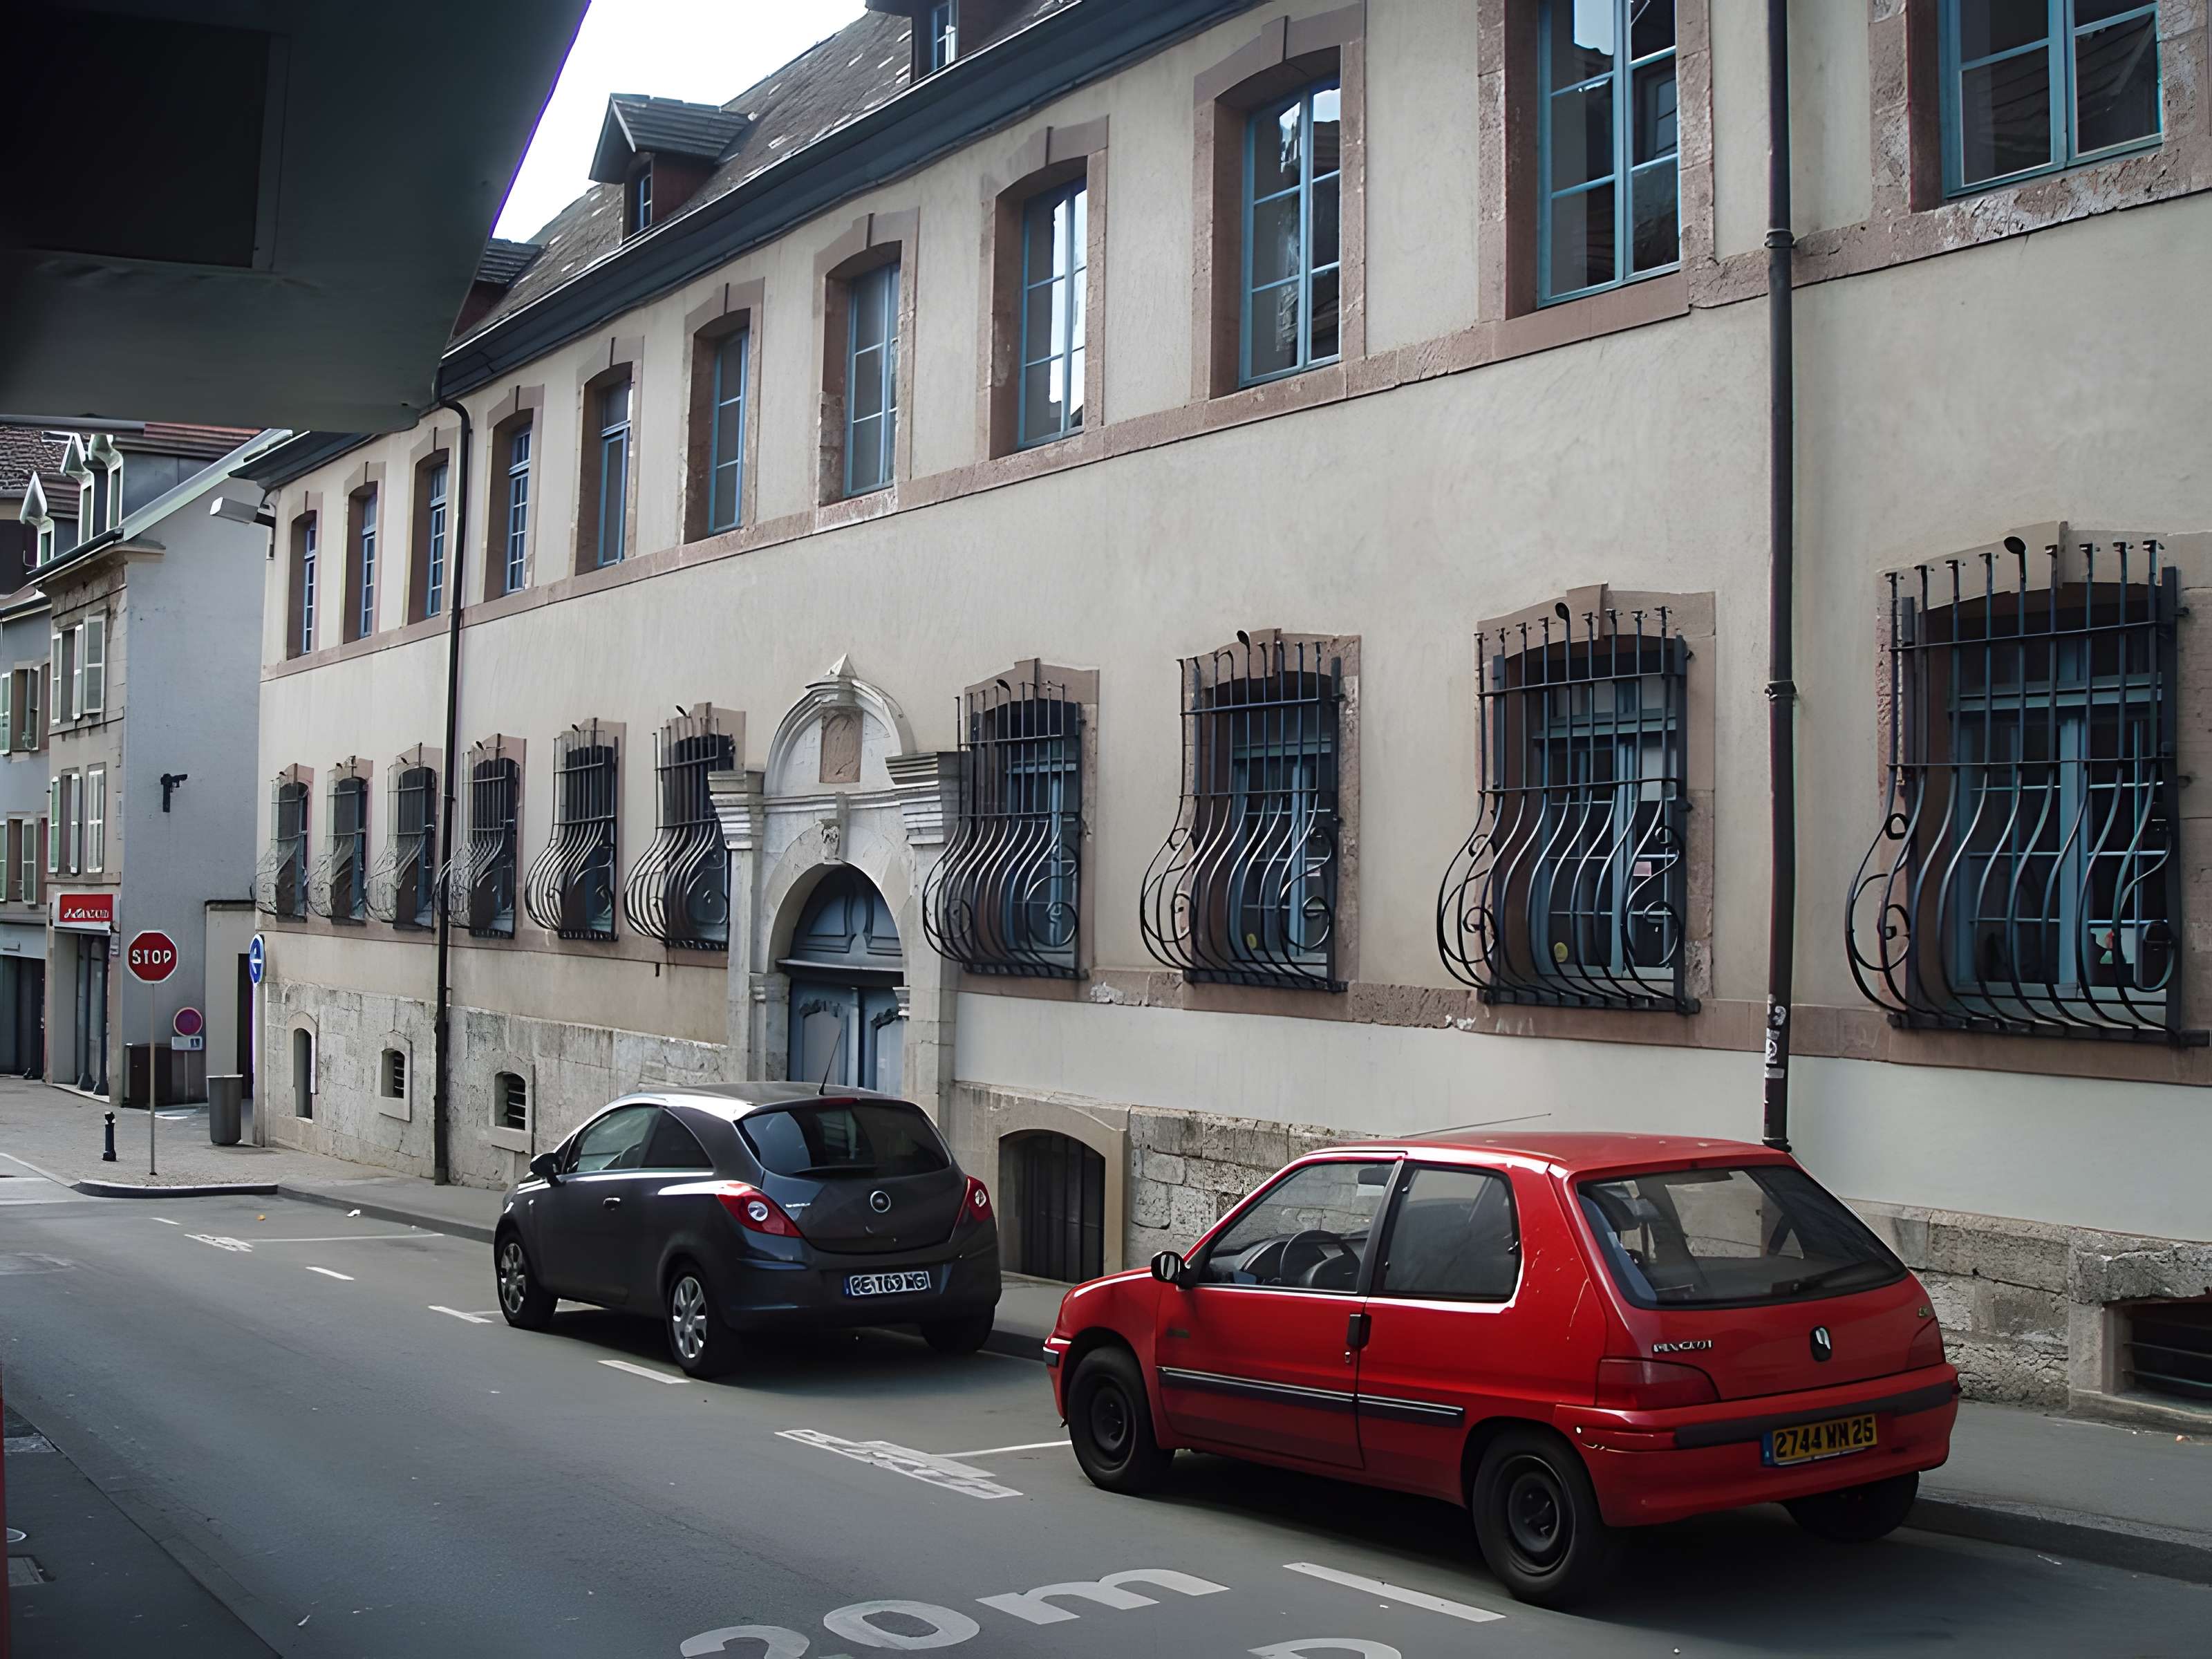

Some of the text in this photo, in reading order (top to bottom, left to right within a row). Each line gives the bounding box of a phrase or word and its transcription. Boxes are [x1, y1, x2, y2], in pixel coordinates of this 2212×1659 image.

[132, 949, 171, 964] STOP
[1775, 1427, 1822, 1458] 2744
[1853, 1417, 1874, 1444] 25
